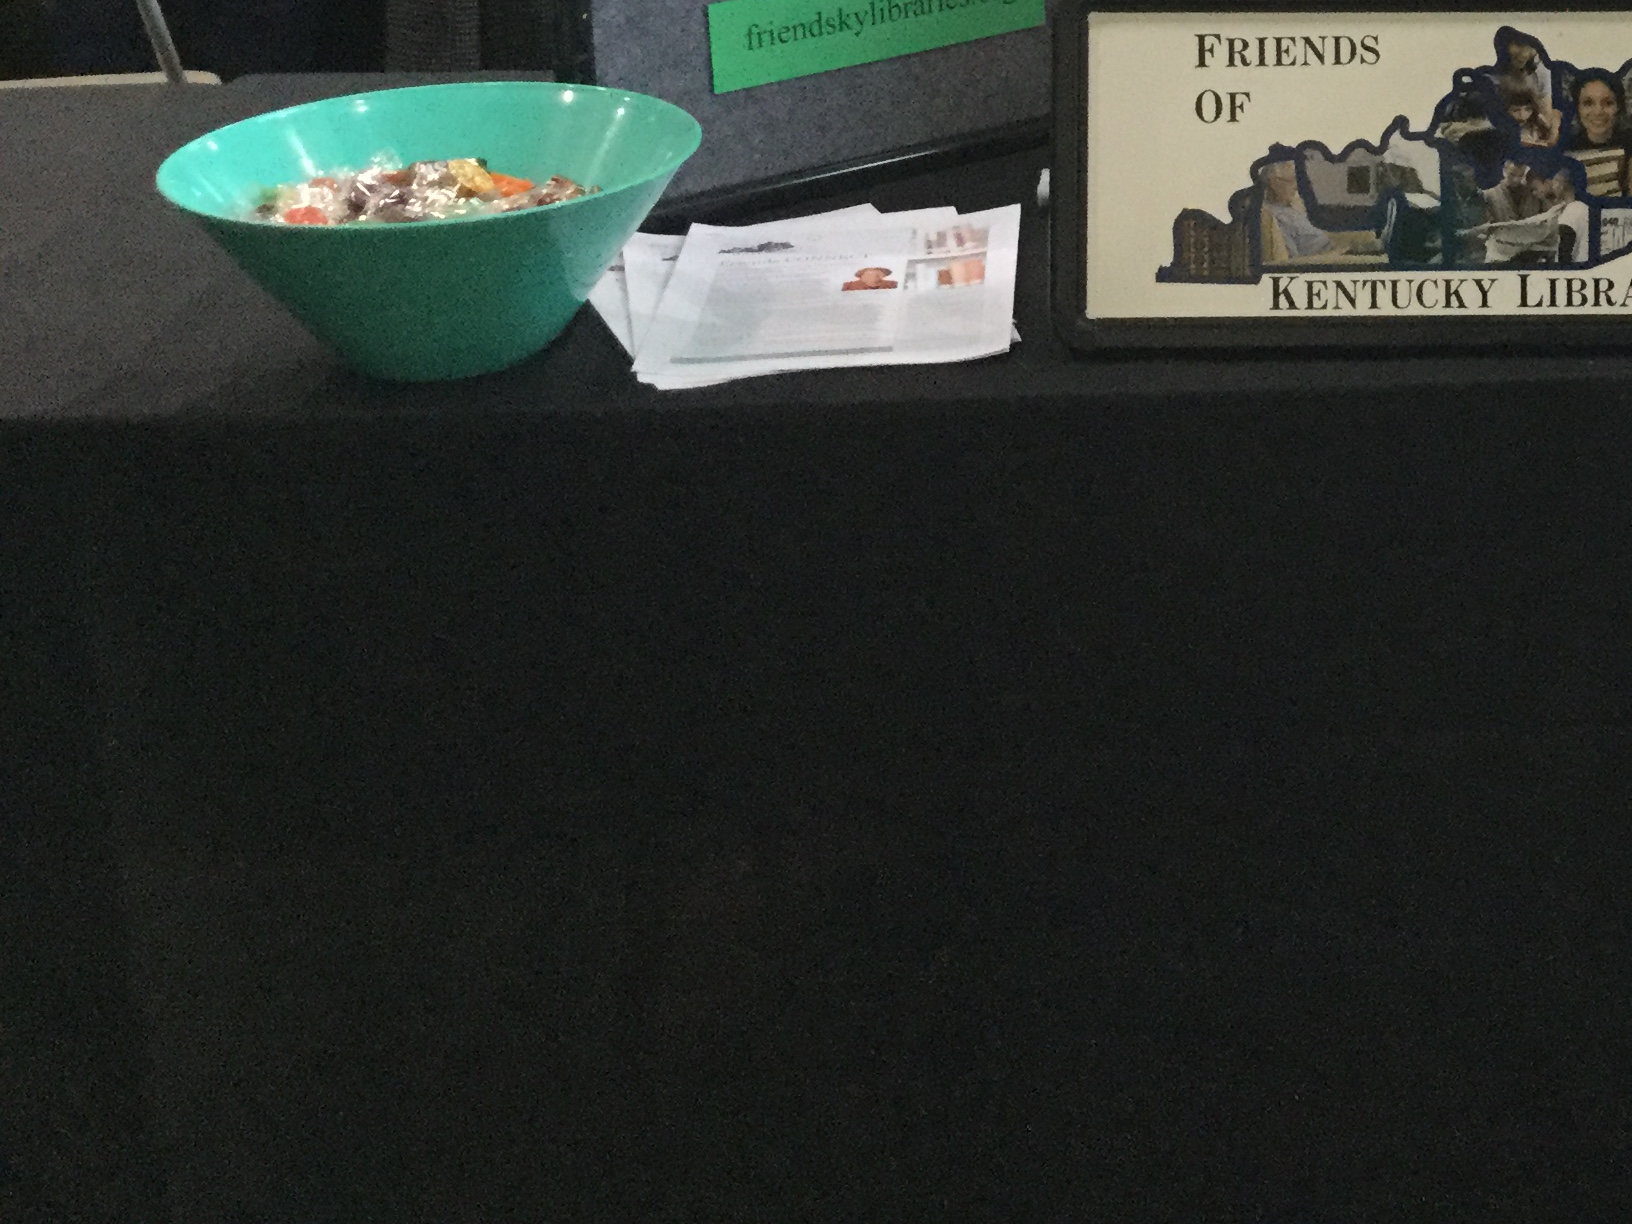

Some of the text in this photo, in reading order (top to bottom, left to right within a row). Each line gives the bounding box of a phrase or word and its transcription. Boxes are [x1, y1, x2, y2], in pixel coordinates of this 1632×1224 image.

[1194, 33, 1381, 69] FRIENDS
[1194, 88, 1252, 124] OF
[1269, 275, 1498, 311] KENTUCKY
